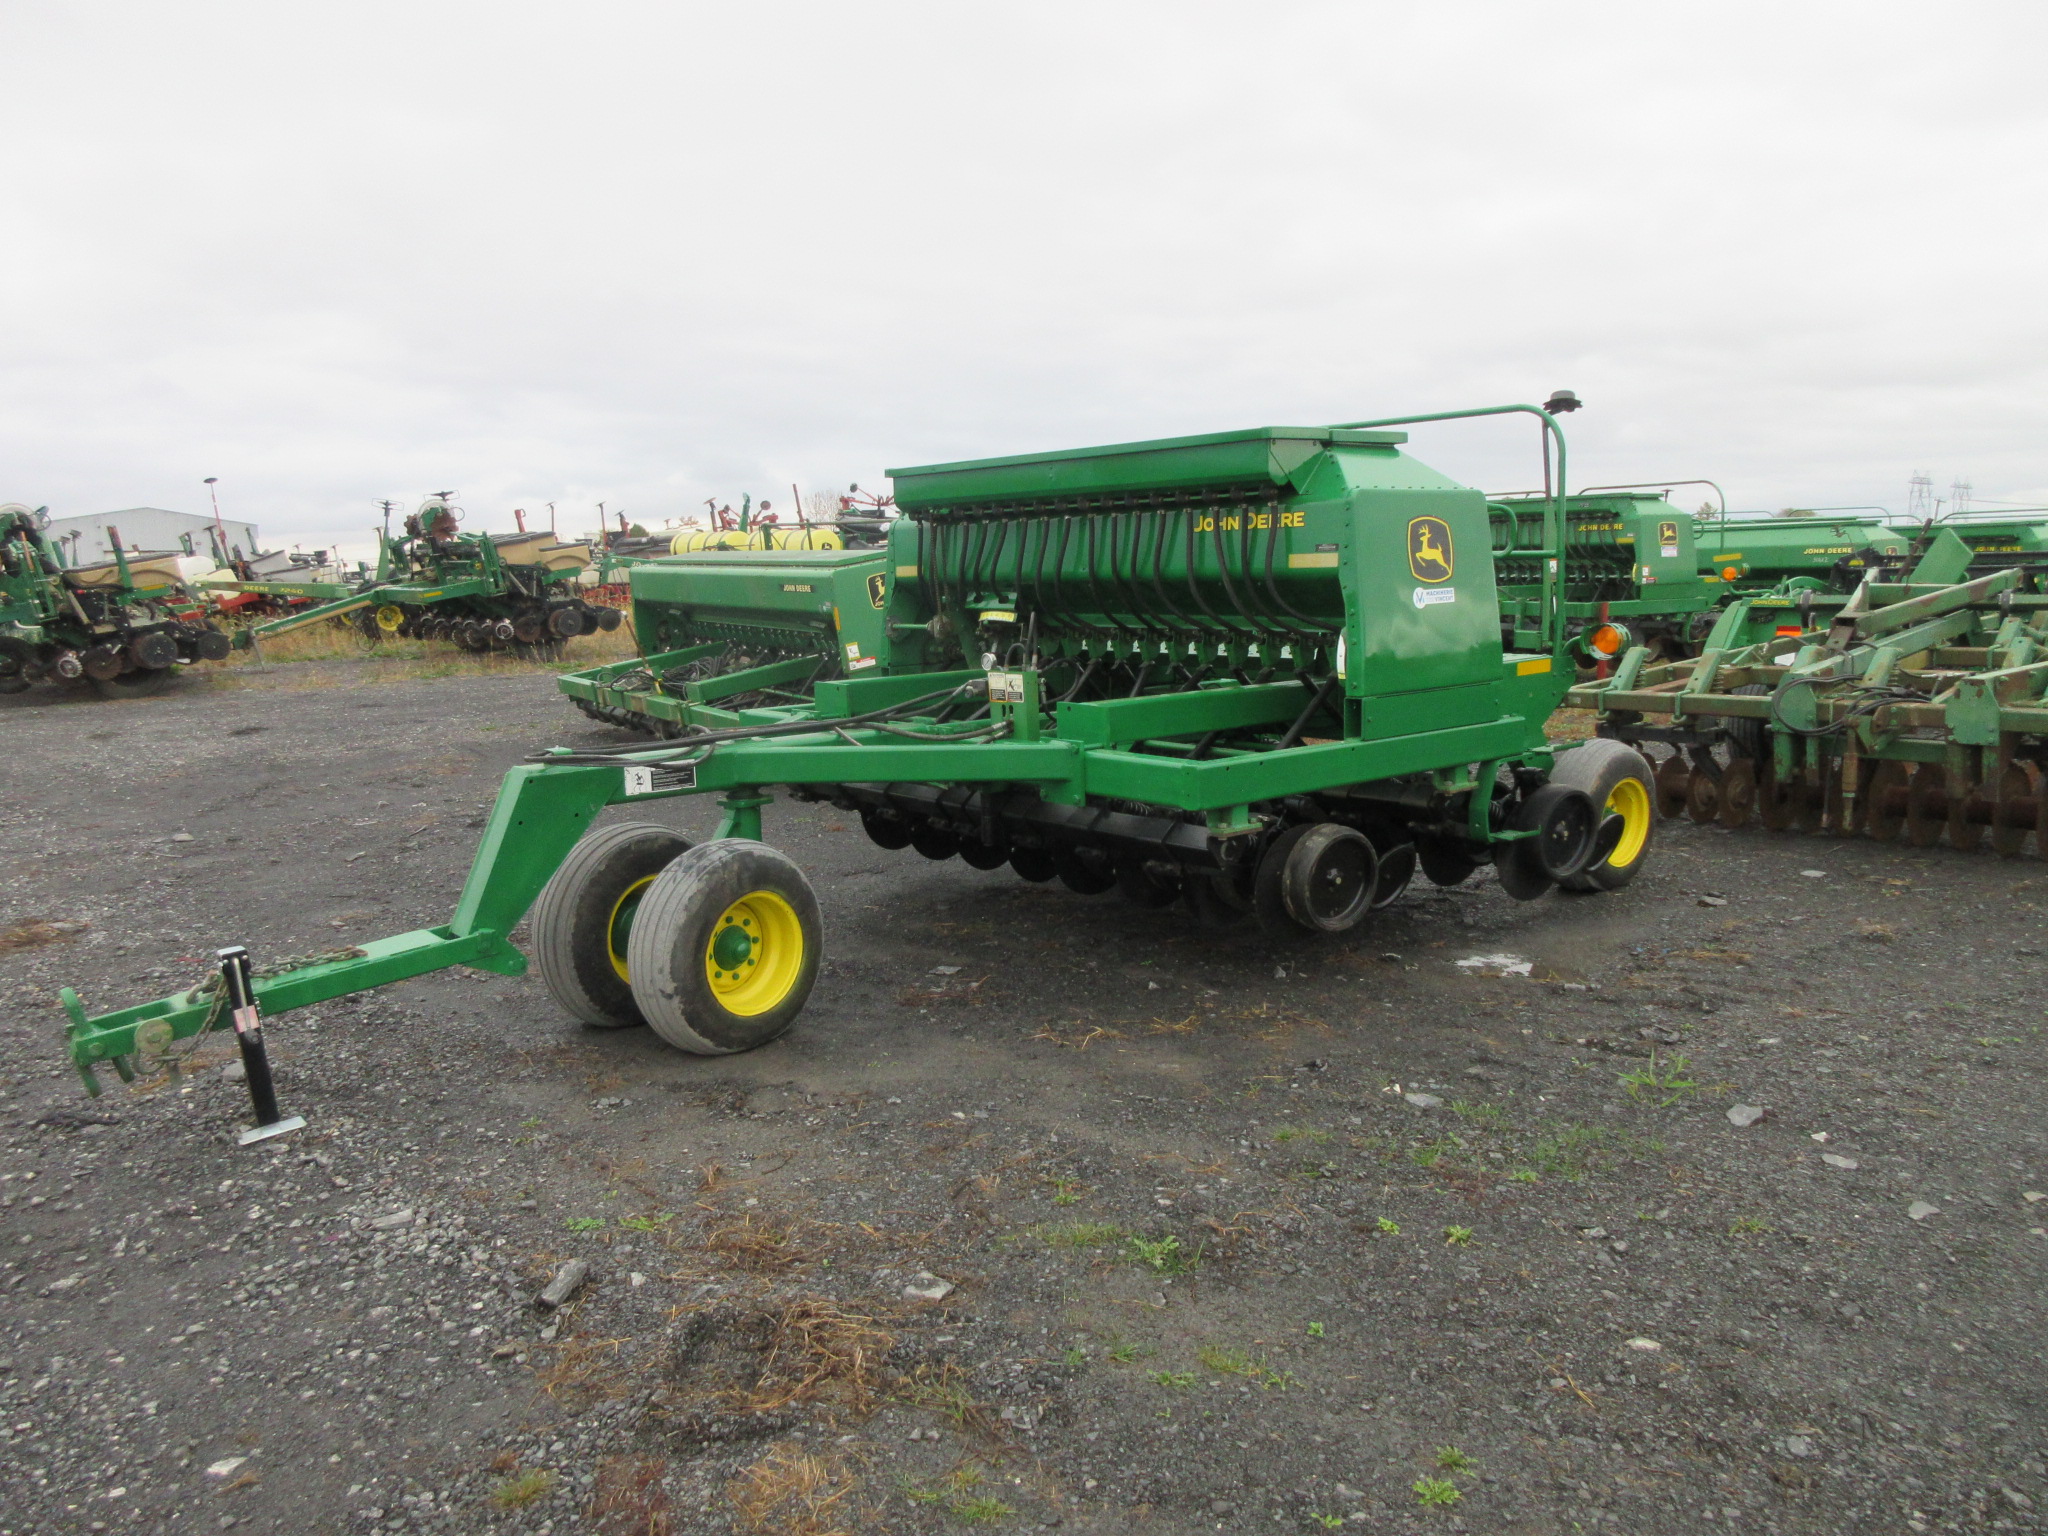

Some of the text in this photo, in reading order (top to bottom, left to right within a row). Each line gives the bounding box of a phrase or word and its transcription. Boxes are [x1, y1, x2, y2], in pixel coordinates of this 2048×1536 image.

[1193, 515, 1239, 533] JOHN
[1600, 523, 1623, 531] DERE
[783, 584, 811, 592] JOHN DEERE
